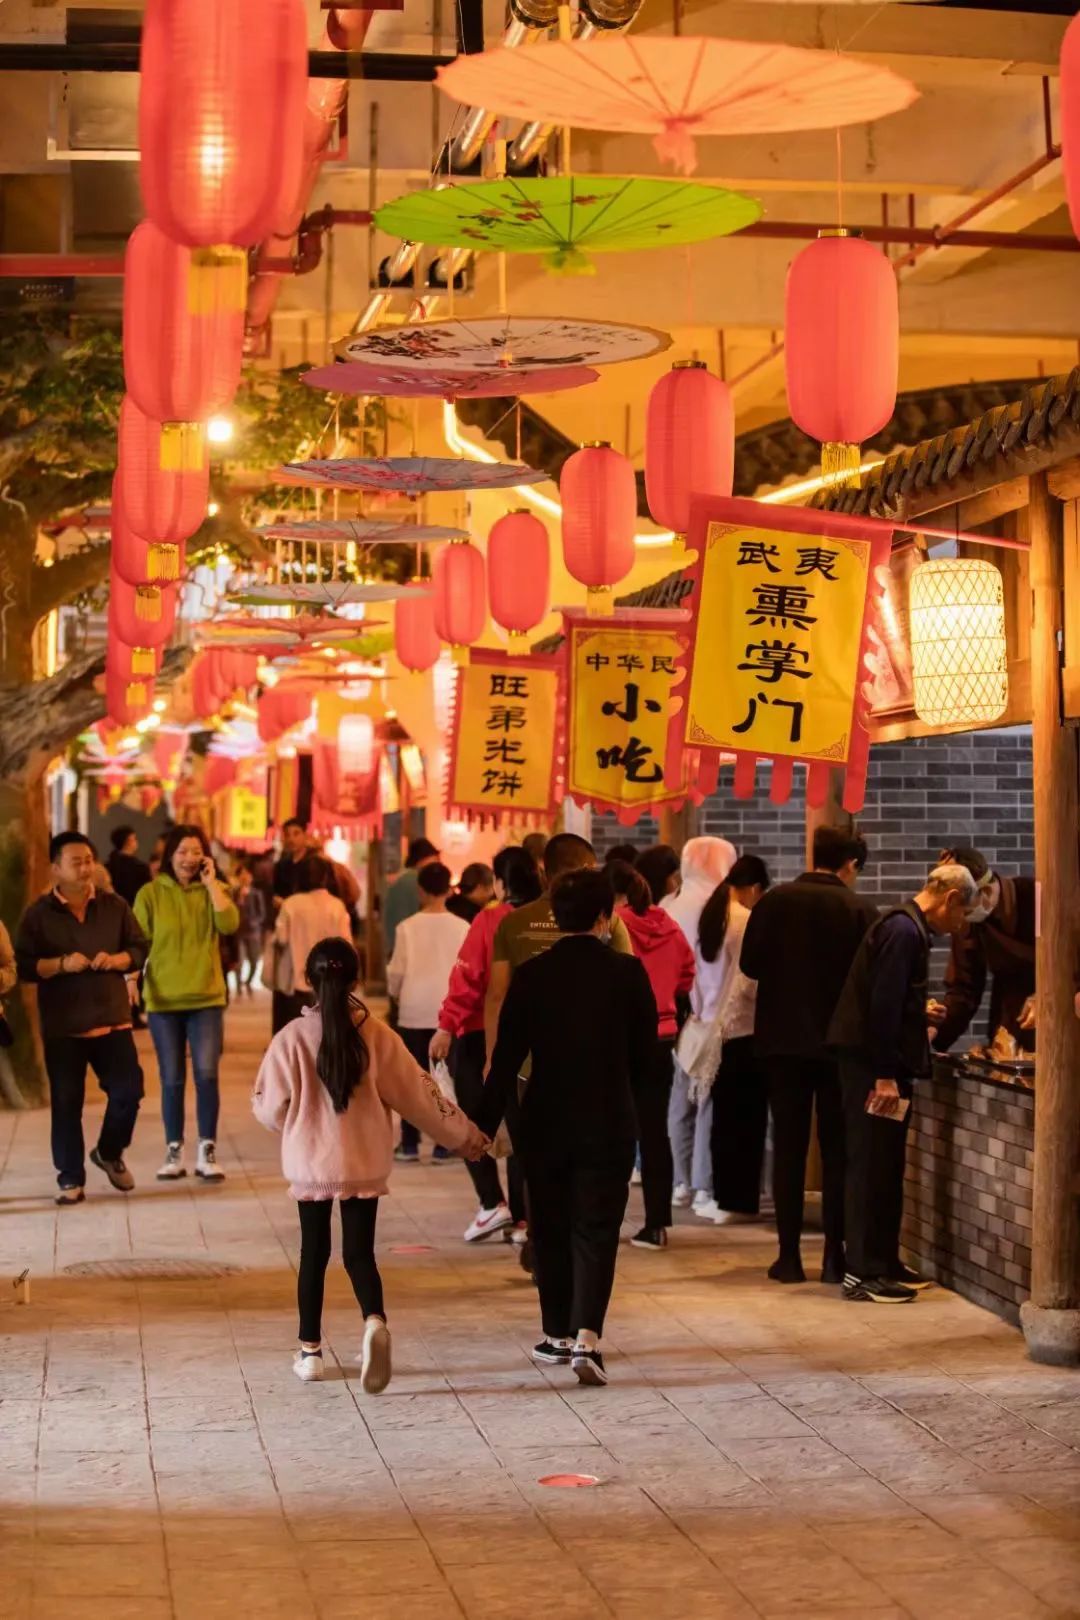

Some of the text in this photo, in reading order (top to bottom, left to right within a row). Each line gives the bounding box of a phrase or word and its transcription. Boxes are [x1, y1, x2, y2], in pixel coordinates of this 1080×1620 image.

[736, 541, 840, 581] 武夷
[731, 583, 818, 743] 熏掌门
[596, 682, 664, 783] 小吃
